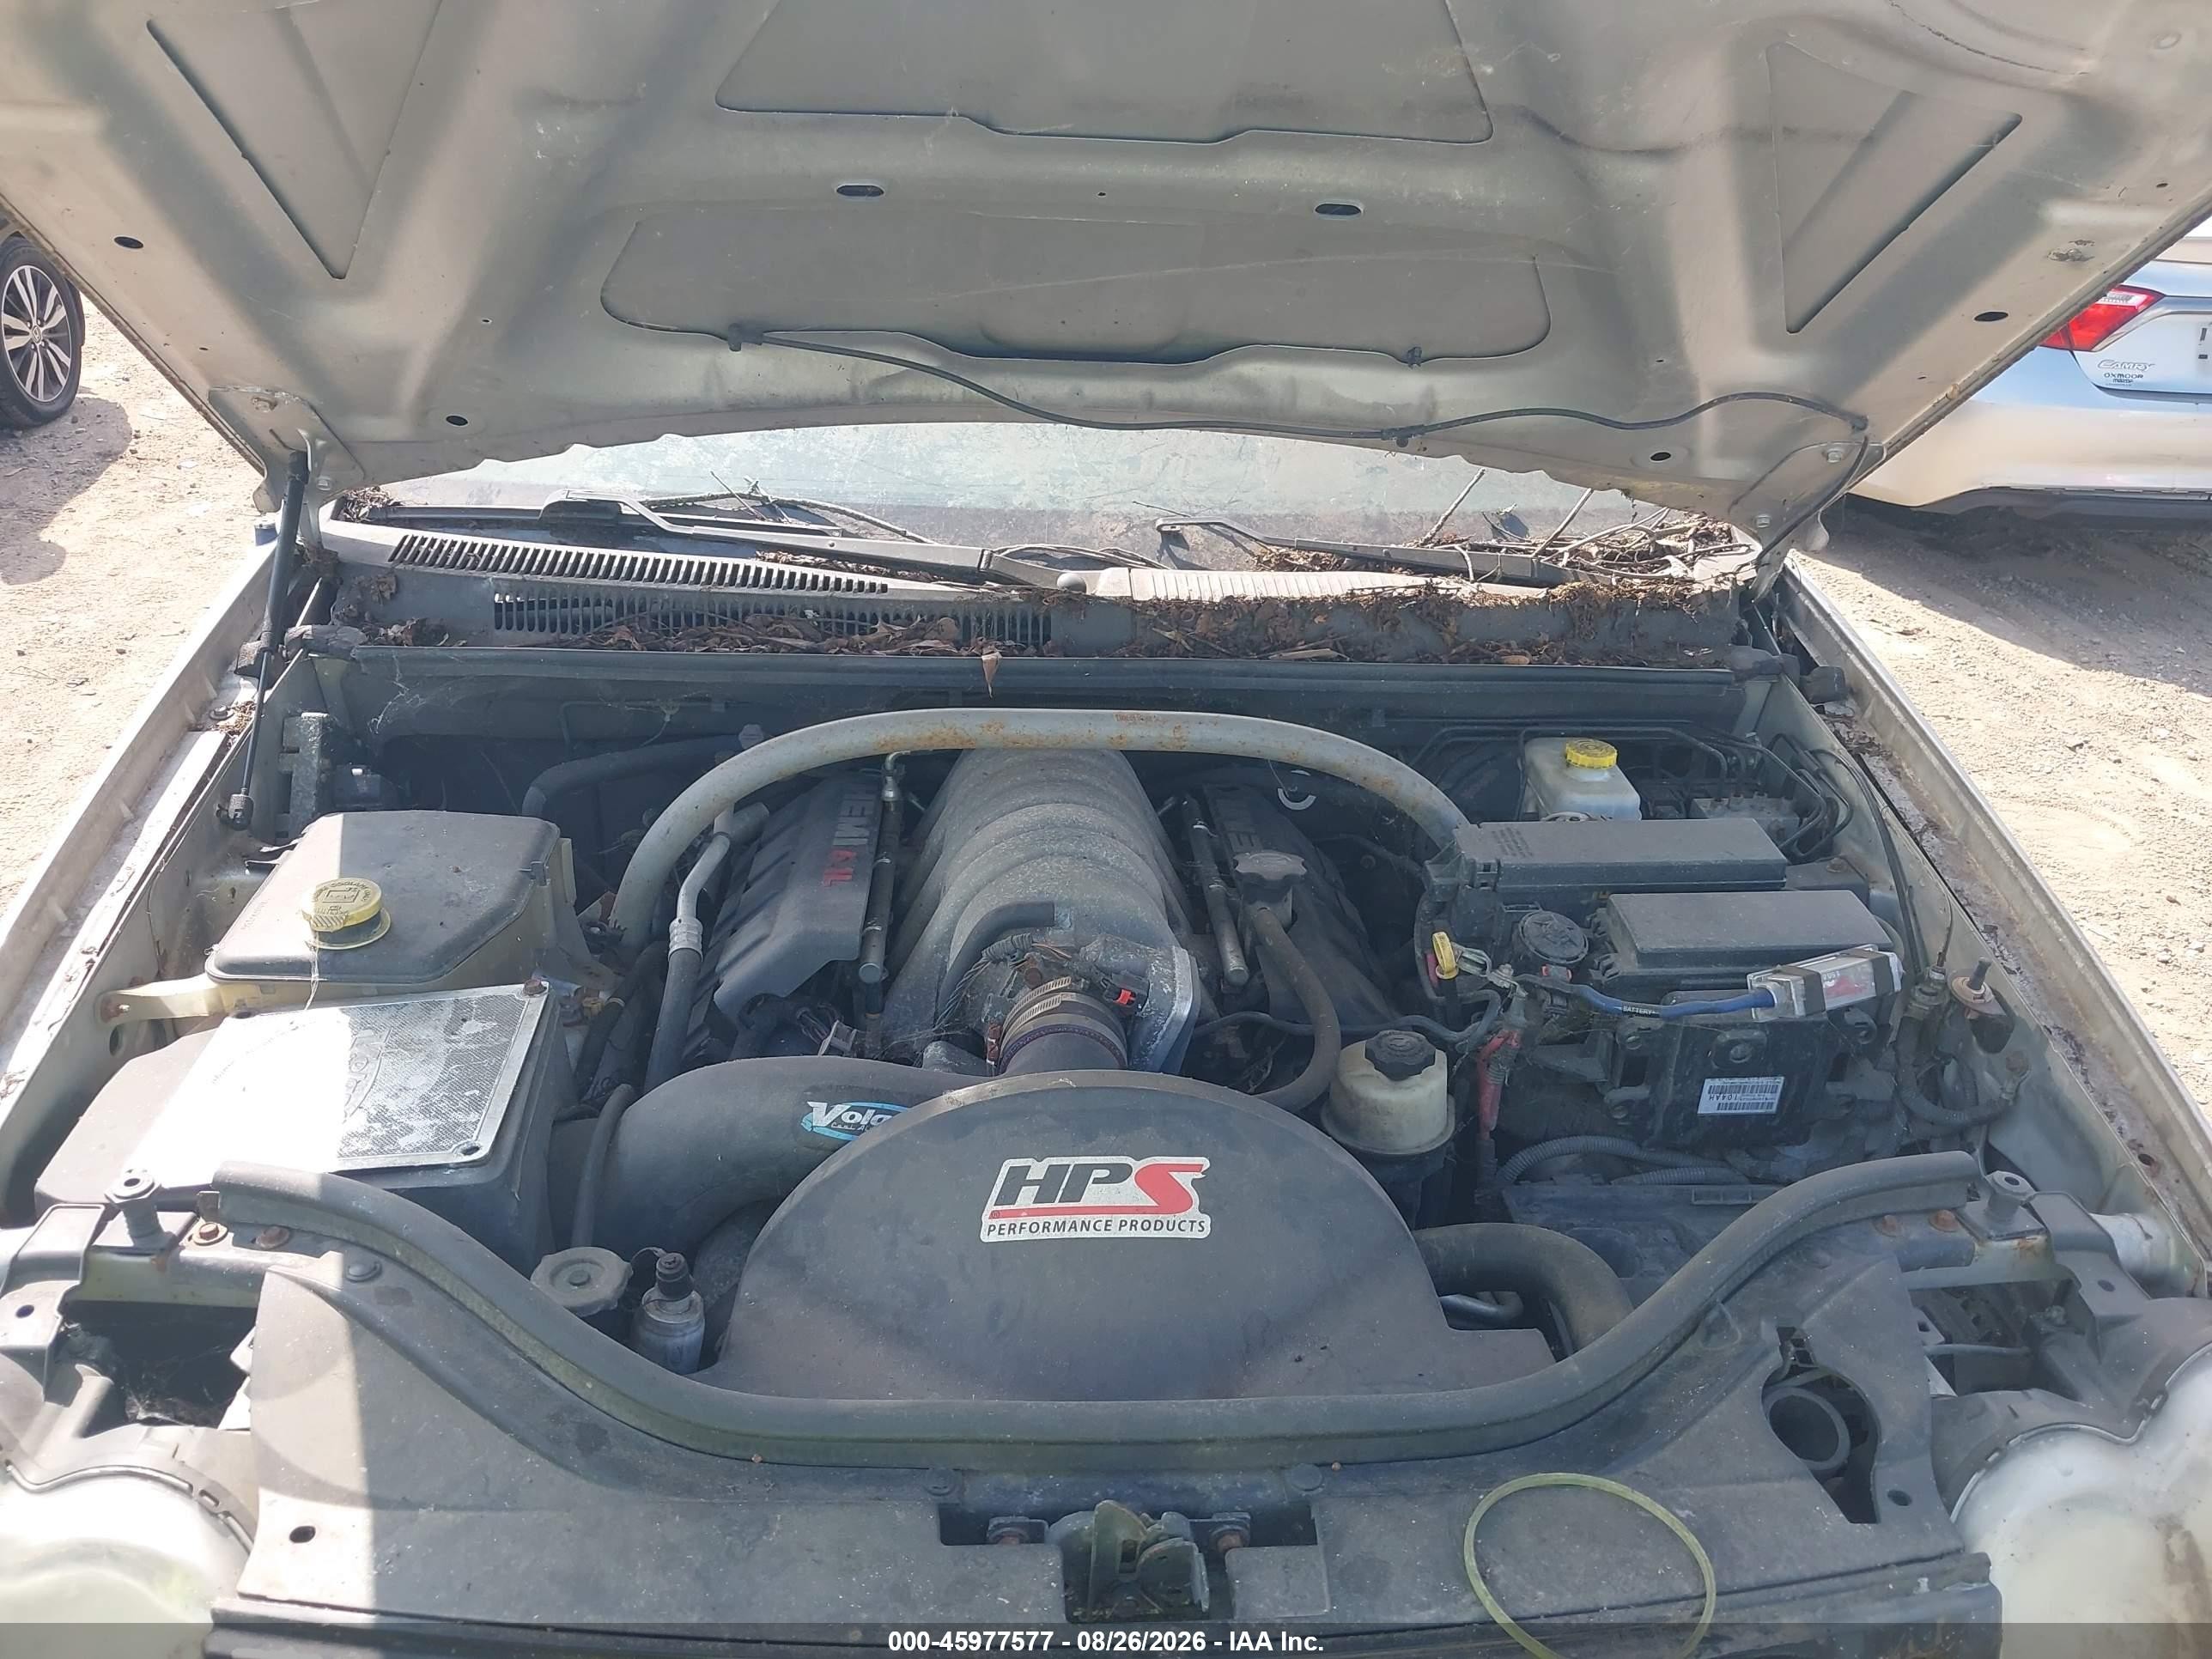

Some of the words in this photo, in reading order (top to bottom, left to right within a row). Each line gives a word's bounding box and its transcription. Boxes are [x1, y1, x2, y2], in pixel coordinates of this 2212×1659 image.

[989, 1163, 1204, 1215] HPS
[988, 1219, 1113, 1237] PERFORMANCE
[1118, 1219, 1206, 1233] PRODUCTS
